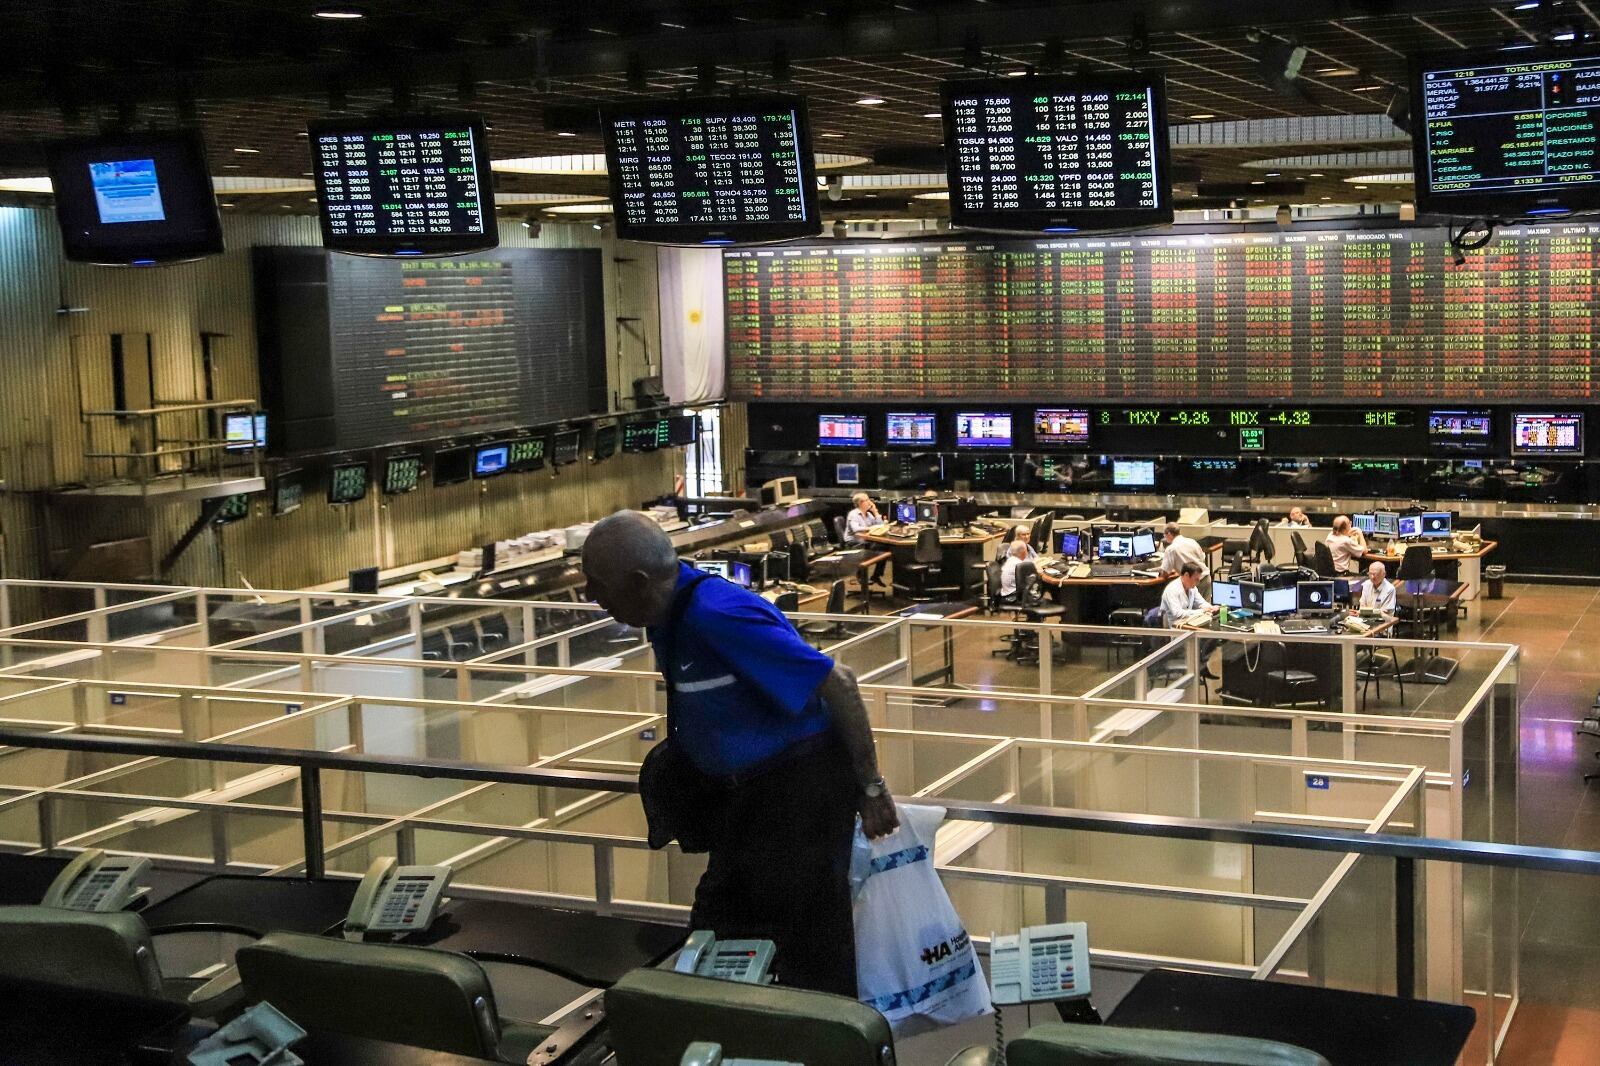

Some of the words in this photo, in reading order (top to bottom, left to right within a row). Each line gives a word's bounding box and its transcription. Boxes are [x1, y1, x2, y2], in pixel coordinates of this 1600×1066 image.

[1532, 62, 1571, 71] OPERADO
[1547, 124, 1593, 132] CAUCIONES
[1547, 137, 1596, 145] PRESTAMOS
[1129, 411, 1160, 425] MXY
[1230, 411, 1259, 425] NDX
[1312, 778, 1324, 786] 28
